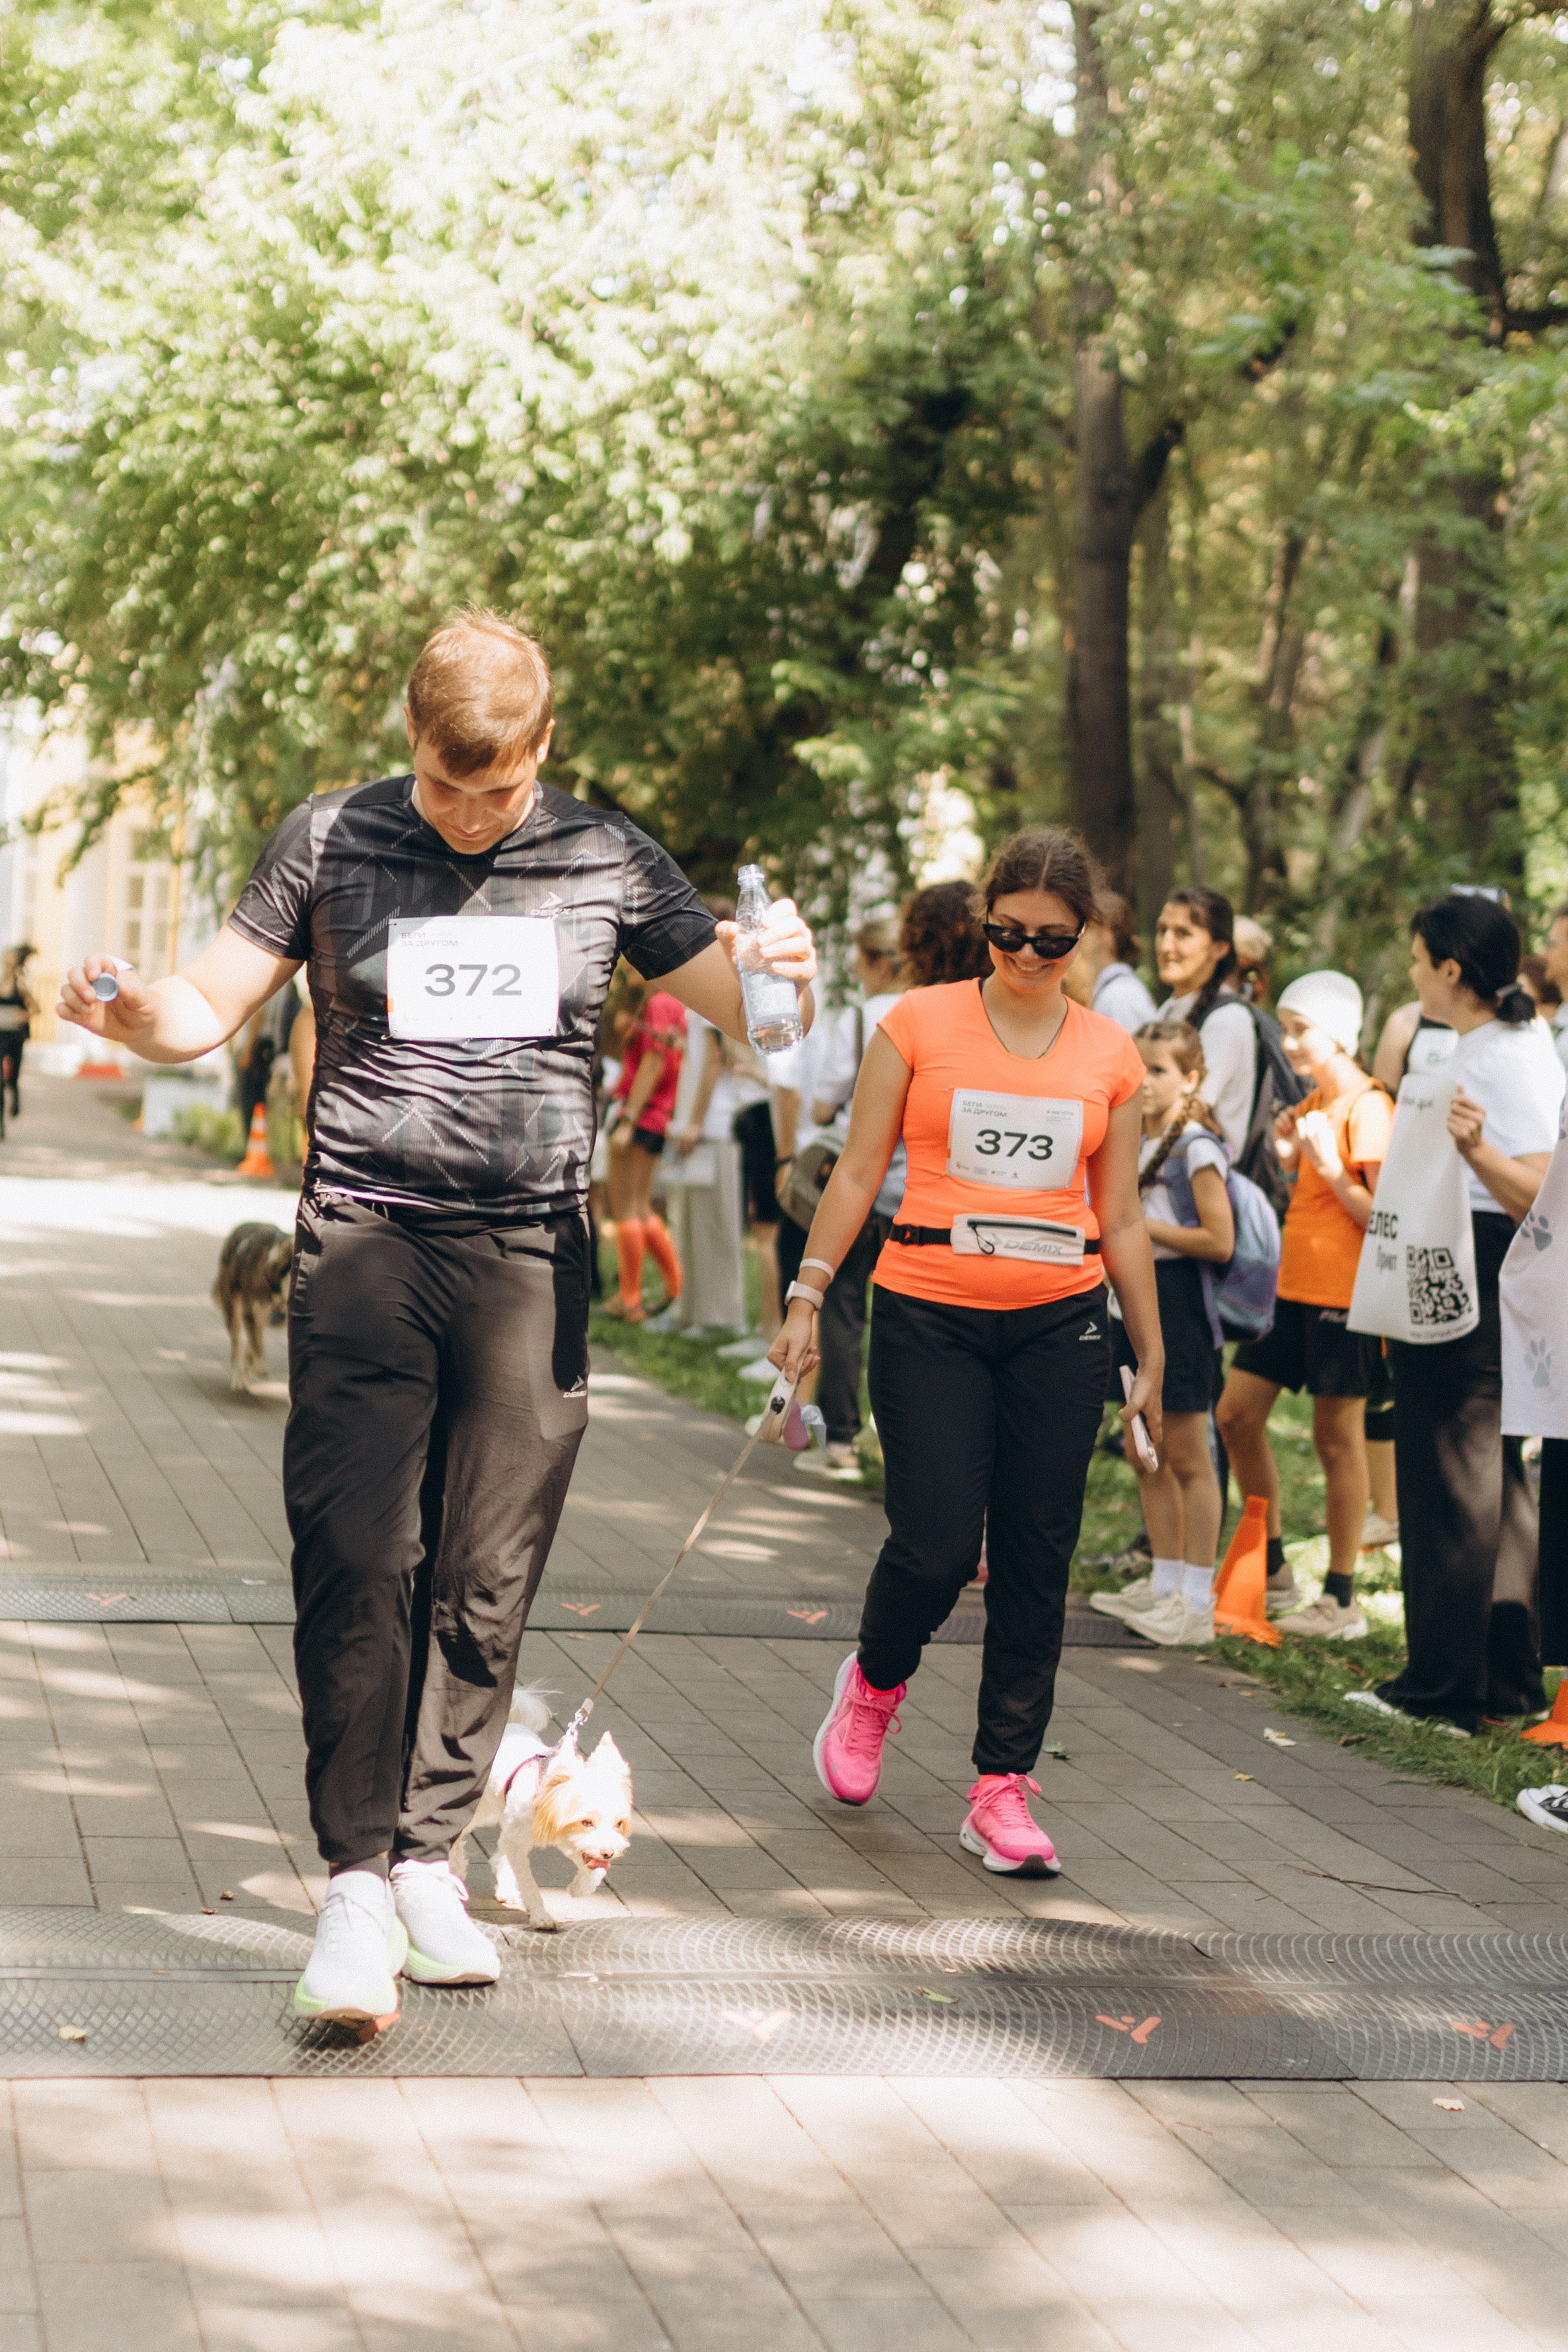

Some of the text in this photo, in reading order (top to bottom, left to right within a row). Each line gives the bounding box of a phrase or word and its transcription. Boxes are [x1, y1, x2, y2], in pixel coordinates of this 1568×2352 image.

[424, 963, 522, 997] 372
[973, 1108, 1007, 1117] ДРУГОМ
[975, 1128, 1053, 1161] 373
[1003, 1239, 1063, 1255] DEMIX
